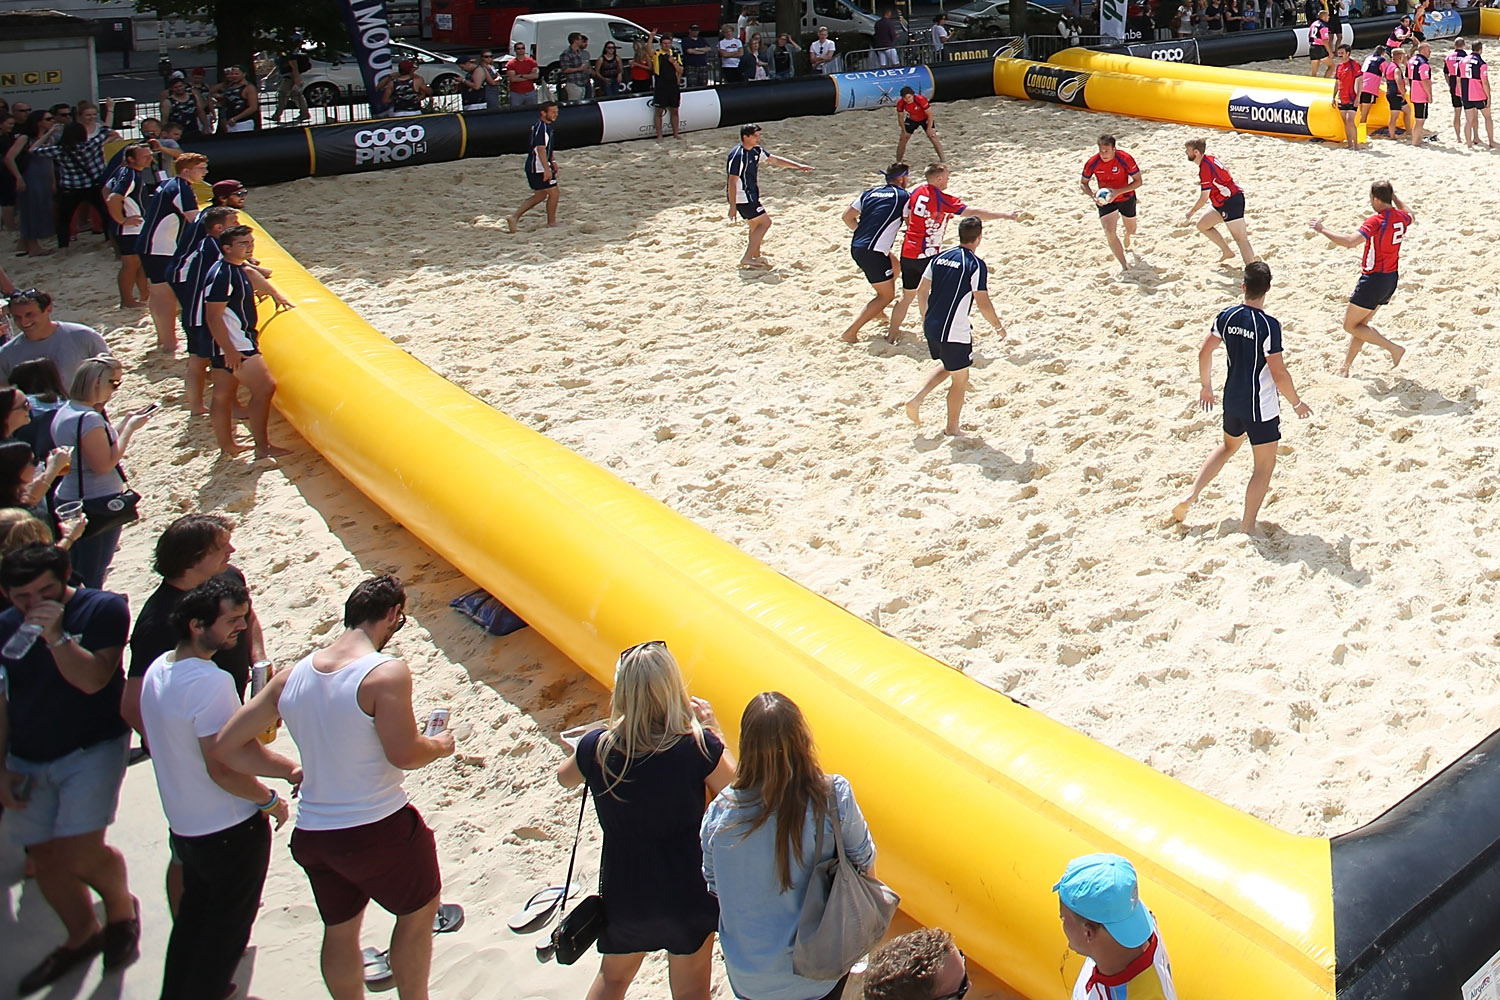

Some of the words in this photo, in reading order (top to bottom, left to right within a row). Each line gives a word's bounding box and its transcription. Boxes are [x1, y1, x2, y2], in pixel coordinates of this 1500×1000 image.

[1151, 47, 1183, 61] COCO
[1, 71, 58, 86] NCP
[845, 67, 905, 80] CITYJET
[1465, 63, 1473, 79] 5
[1026, 73, 1059, 91] LONDON
[1229, 104, 1250, 113] SHARP'S
[639, 121, 688, 132] CITYPOTS
[354, 124, 425, 148] COCO
[355, 144, 412, 165] PRO
[914, 194, 930, 218] 6
[1392, 222, 1404, 245] 2
